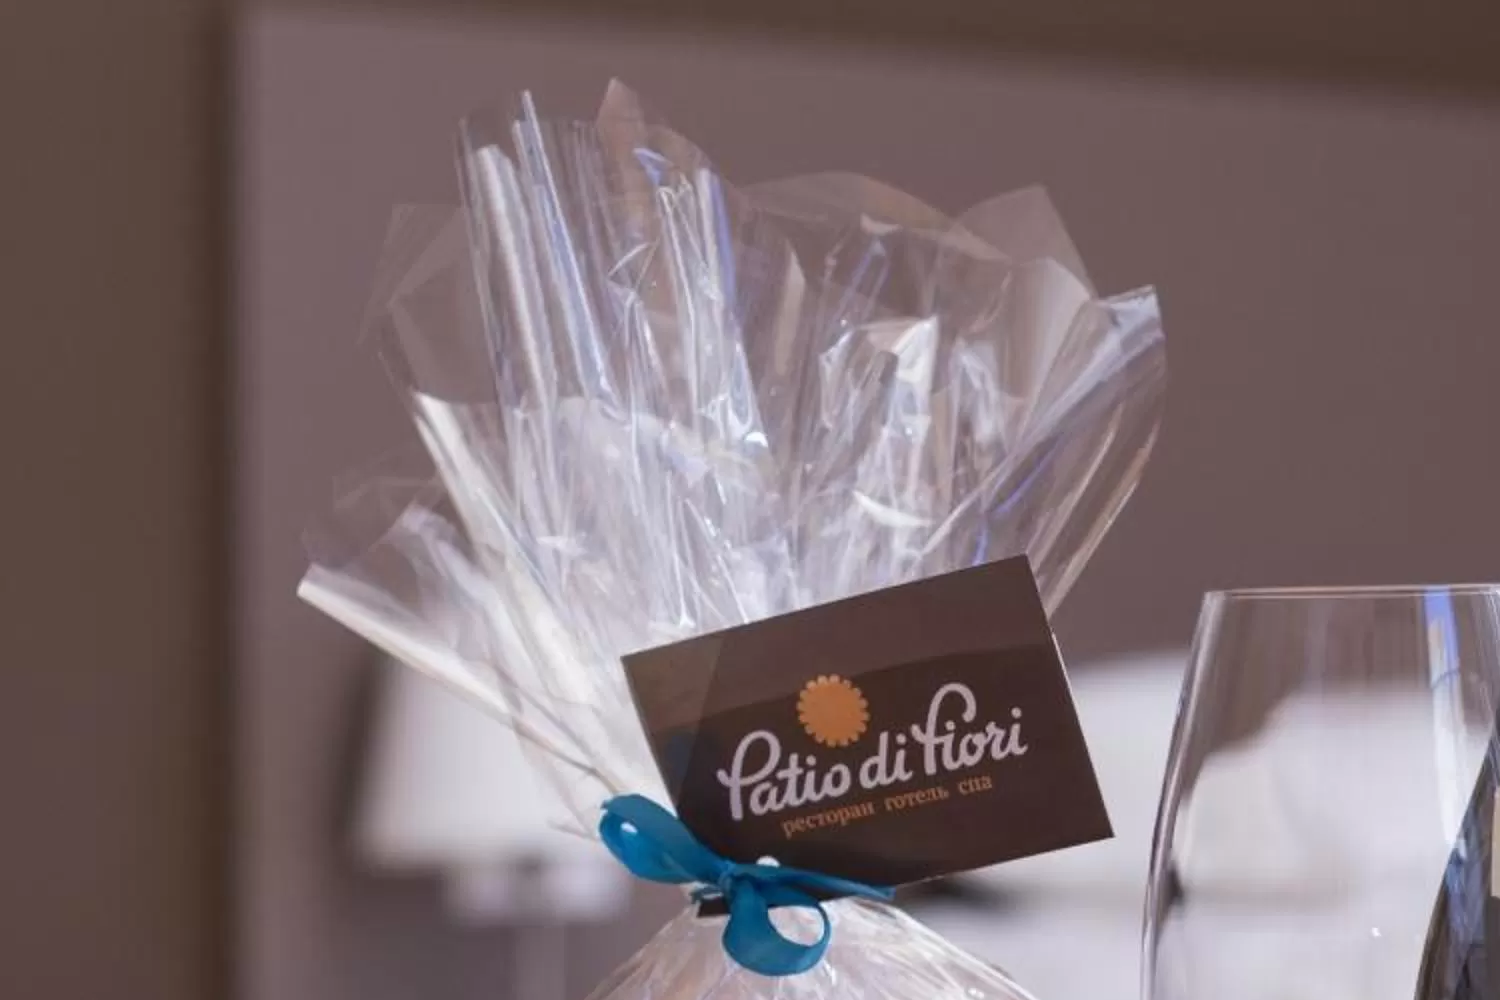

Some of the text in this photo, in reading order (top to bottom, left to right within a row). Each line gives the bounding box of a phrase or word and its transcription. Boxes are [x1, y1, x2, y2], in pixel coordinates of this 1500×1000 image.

[718, 729, 852, 821] Patio
[860, 726, 913, 789] di
[781, 775, 993, 839] ресторан готель спа
